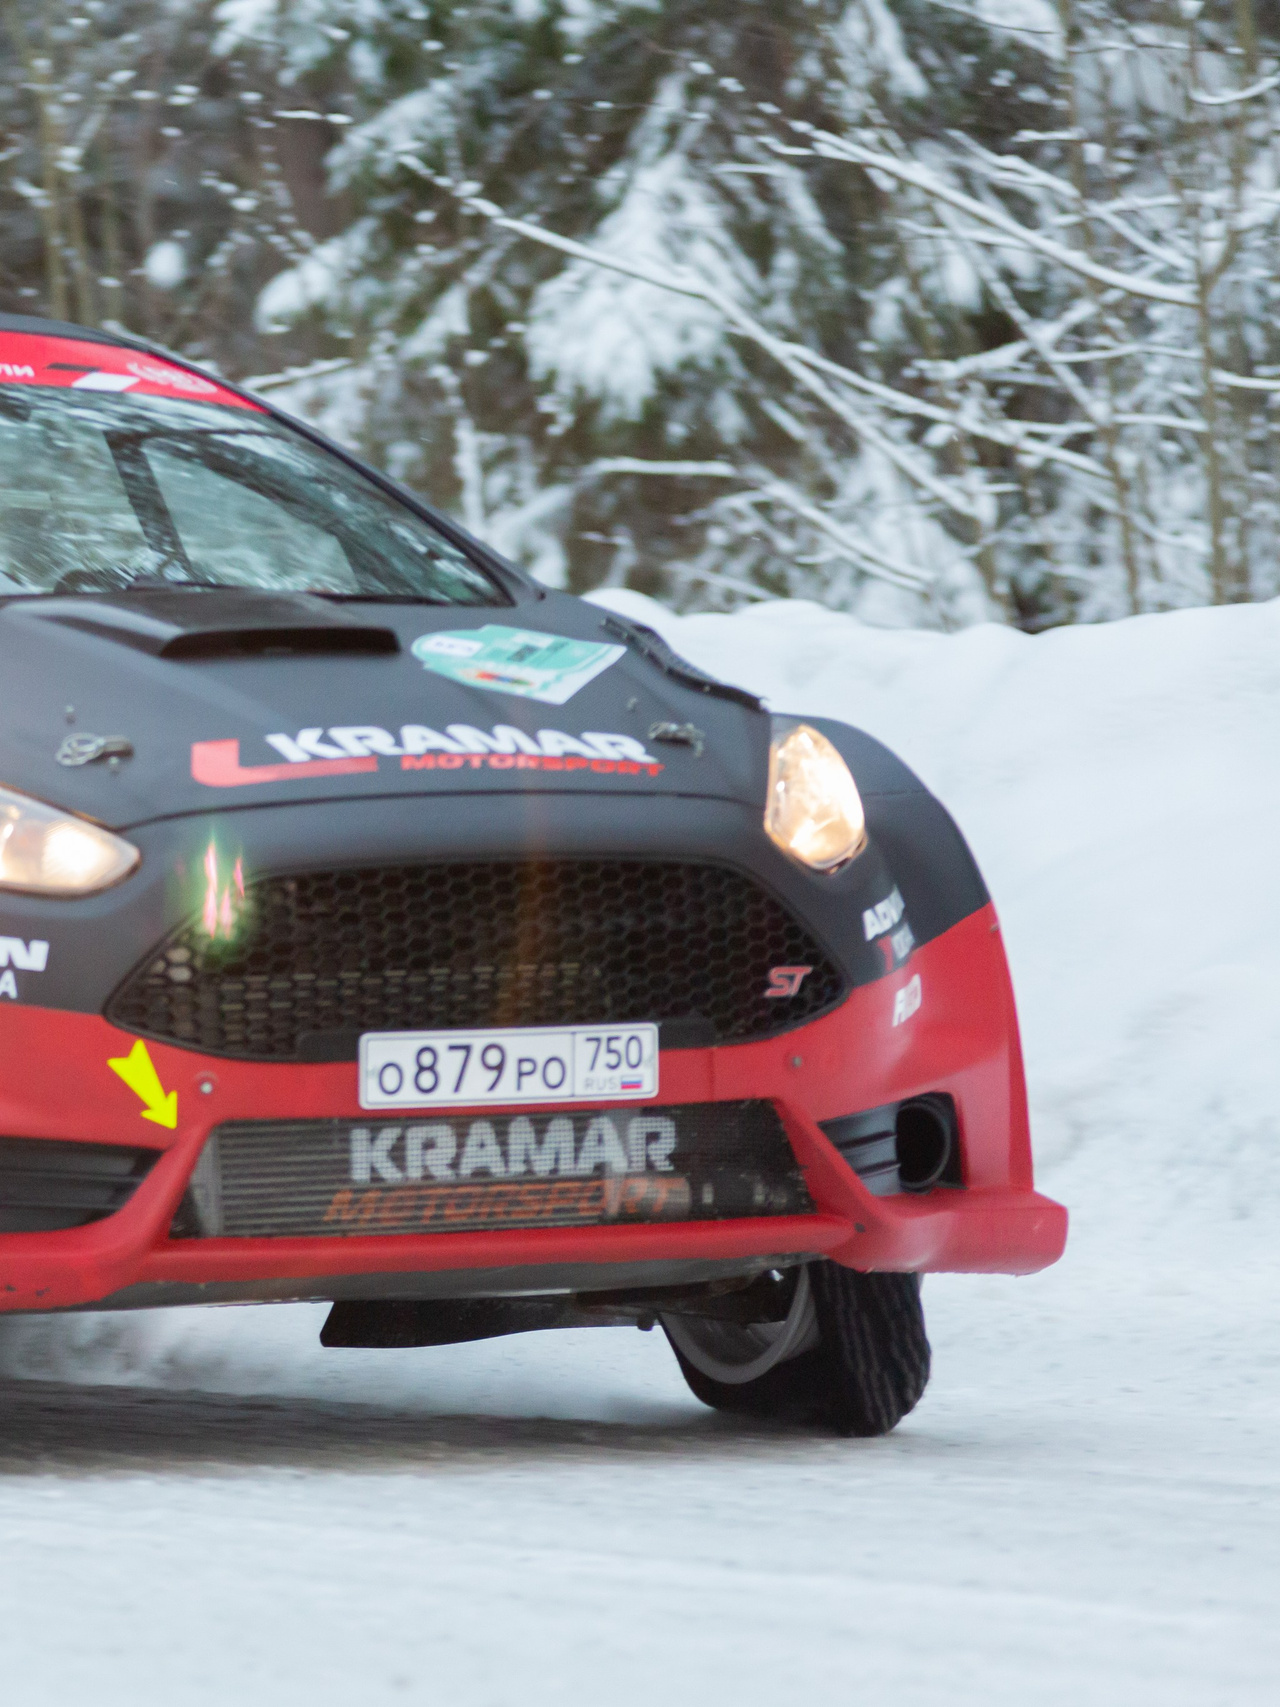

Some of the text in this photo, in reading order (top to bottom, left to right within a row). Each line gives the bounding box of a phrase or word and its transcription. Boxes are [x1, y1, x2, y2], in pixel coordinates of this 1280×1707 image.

[265, 724, 660, 763] KRAMAR
[400, 753, 665, 777] MOTORSPORT
[764, 966, 814, 998] ST
[585, 1034, 644, 1072] 750
[585, 1076, 618, 1091] RUS
[348, 1115, 677, 1184] KRAMAR
